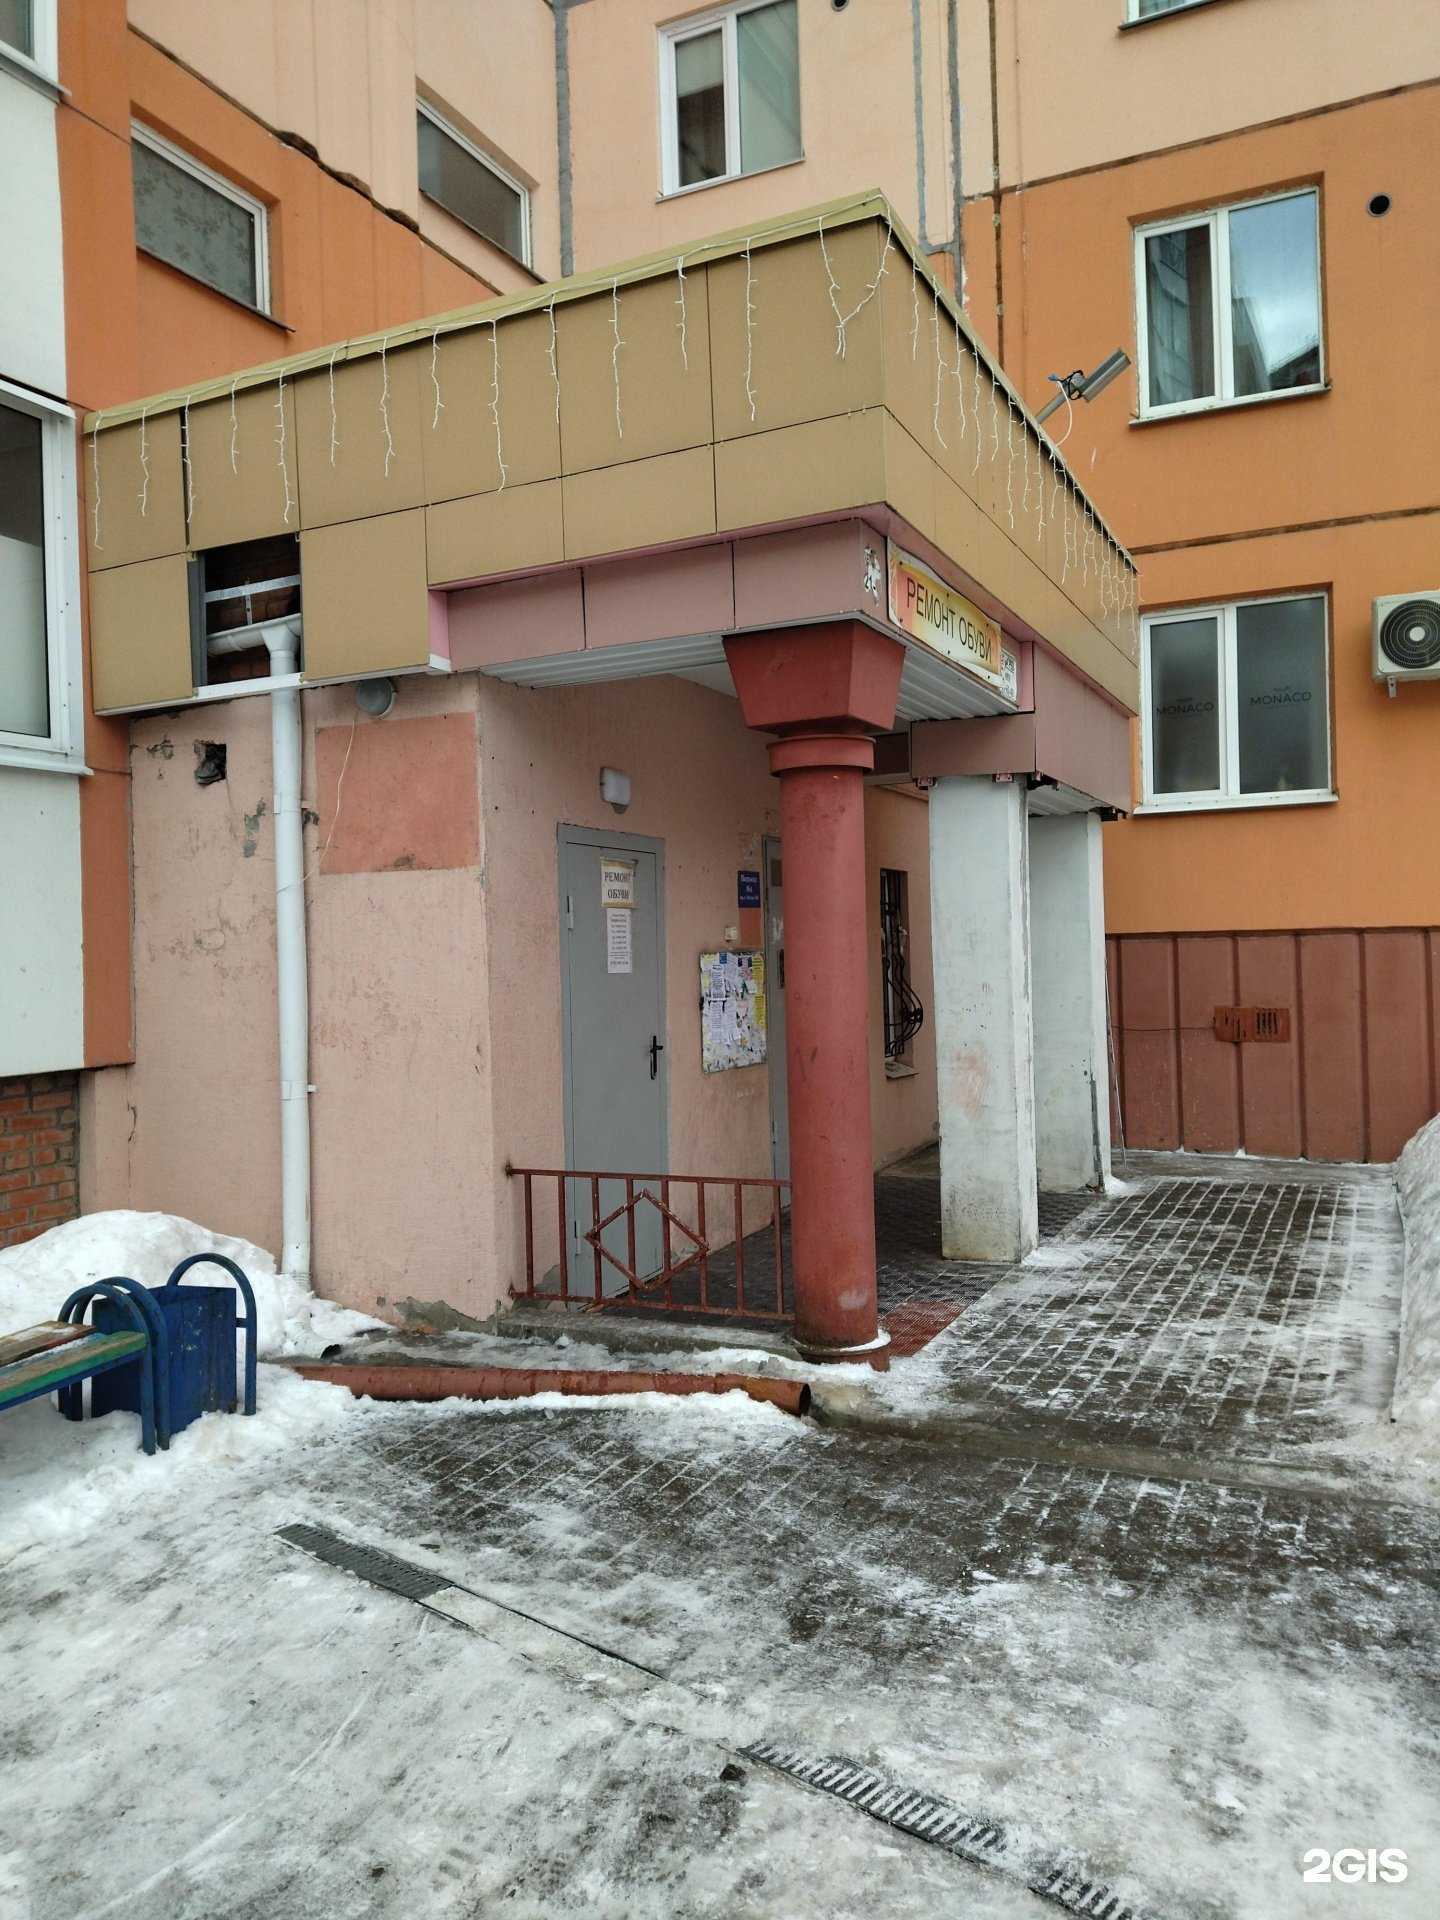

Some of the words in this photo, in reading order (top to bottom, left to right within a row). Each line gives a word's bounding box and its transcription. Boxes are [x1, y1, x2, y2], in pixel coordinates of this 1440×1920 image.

[906, 577, 957, 640] РЕМОНТ
[958, 617, 993, 664] ОБУВИ
[1250, 691, 1313, 706] MONACO
[1156, 701, 1215, 717] MONACO
